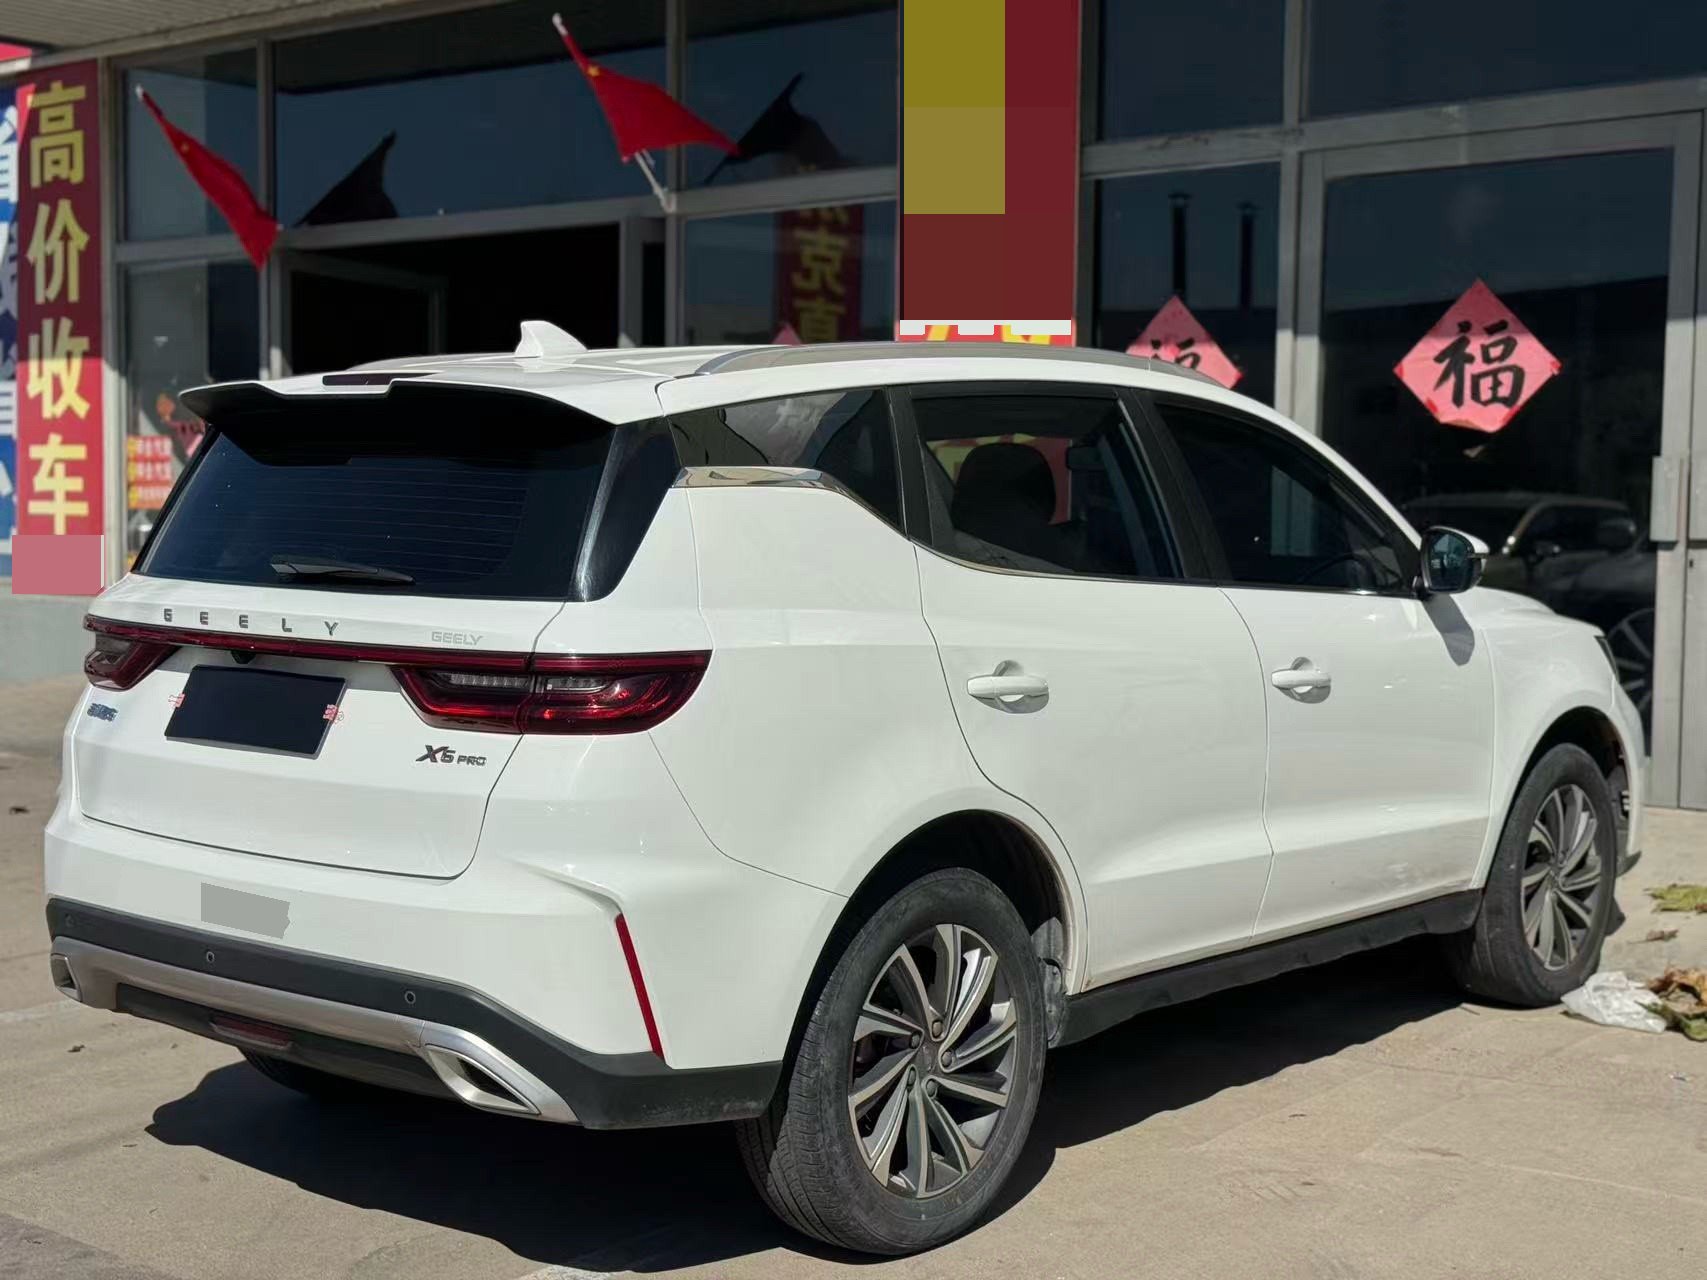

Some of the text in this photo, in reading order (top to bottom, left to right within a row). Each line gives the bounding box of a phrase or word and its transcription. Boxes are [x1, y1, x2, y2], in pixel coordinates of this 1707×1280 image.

[27, 81, 89, 534] 高价收车
[1433, 319, 1526, 409] 福
[163, 608, 339, 637] GEELY
[431, 631, 483, 646] GEELY
